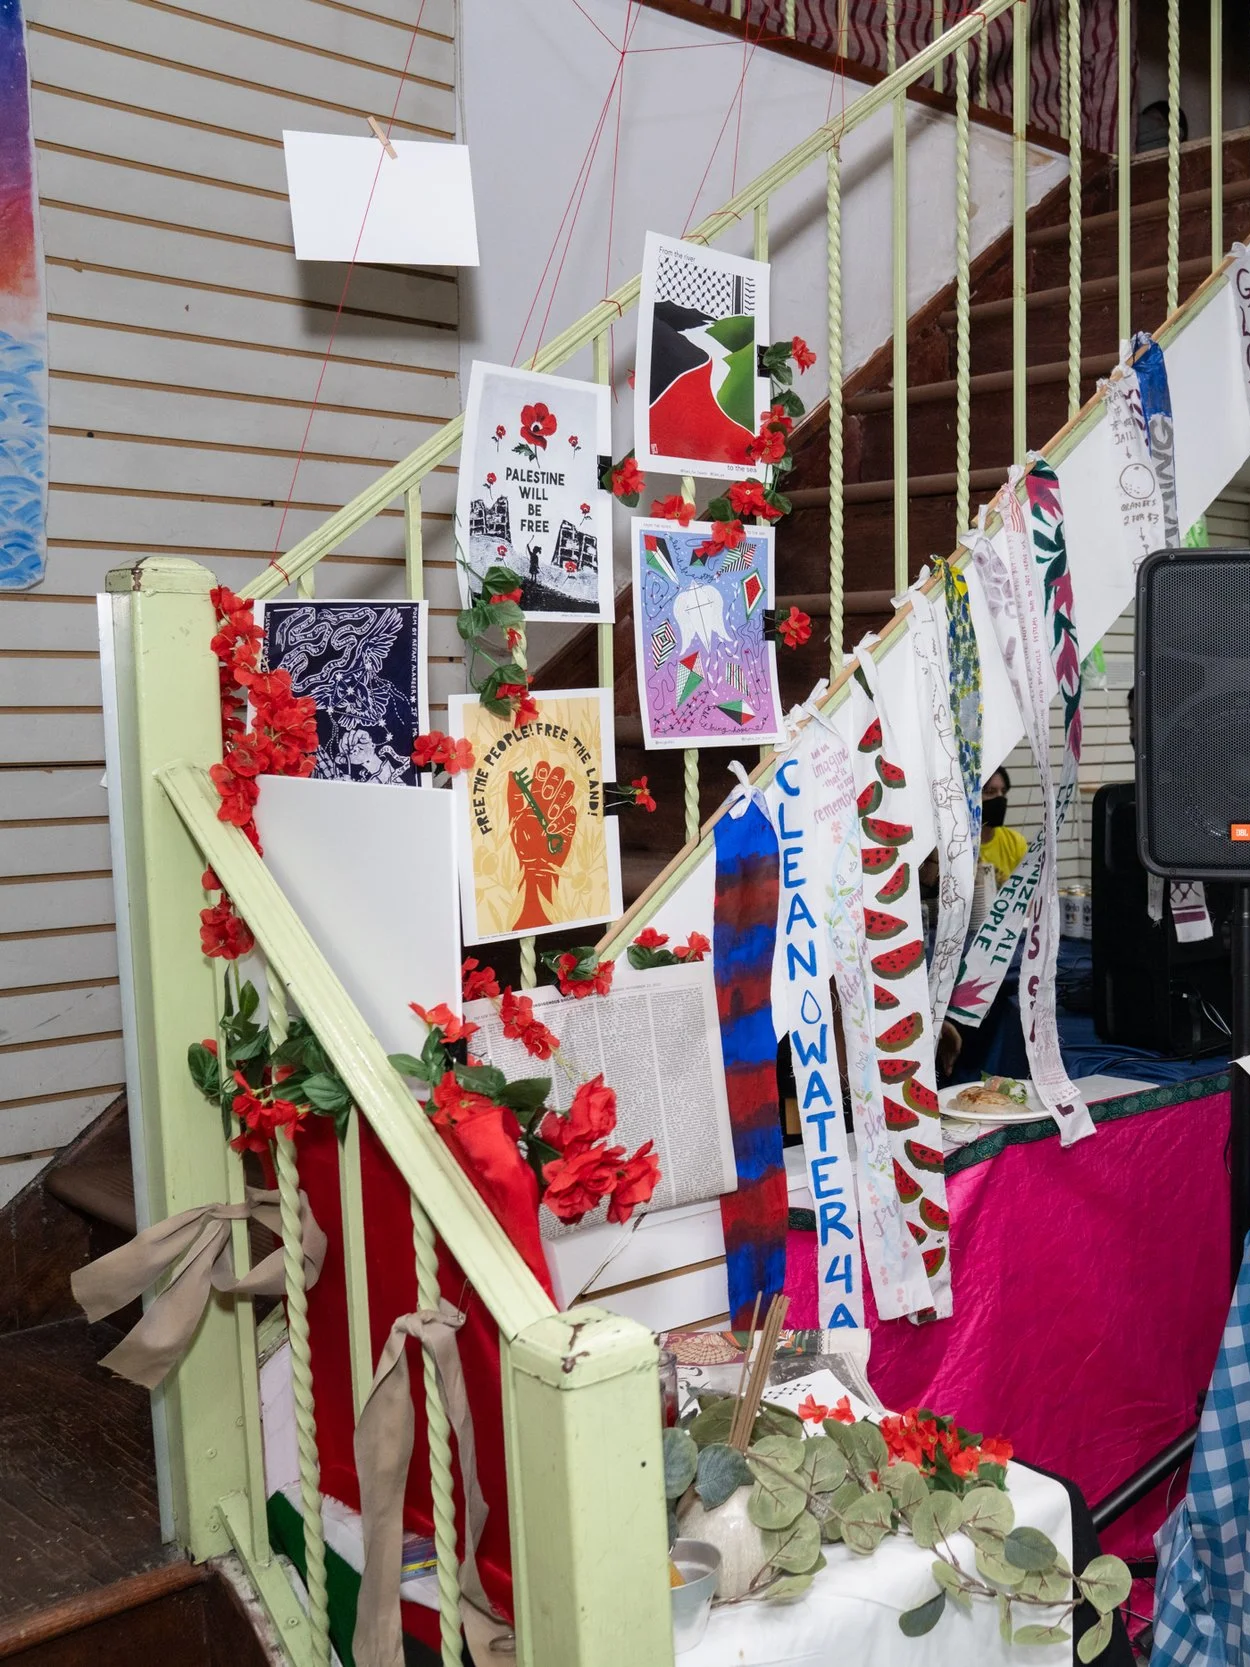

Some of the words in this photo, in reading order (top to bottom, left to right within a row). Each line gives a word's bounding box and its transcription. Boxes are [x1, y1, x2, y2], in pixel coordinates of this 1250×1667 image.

[659, 246, 673, 256] From
[674, 250, 683, 259] the
[685, 253, 696, 262] river
[506, 467, 565, 486] PALESTINE
[735, 465, 745, 473] the
[519, 486, 548, 501] WILL
[528, 504, 542, 516] BE
[1124, 515, 1131, 526] 2
[1132, 514, 1145, 523] FOR
[1147, 513, 1160, 525] $3
[520, 519, 549, 533] FREE
[410, 606, 418, 625] POEM
[410, 627, 418, 636] BY
[409, 638, 418, 662] REFAAT
[409, 664, 418, 696] ALAREER
[484, 723, 534, 767] PEOPLE!
[536, 723, 568, 742] FREE
[573, 736, 592, 765] THE
[812, 747, 849, 778] imagine
[473, 768, 489, 795] THE
[586, 767, 600, 816] LAND!
[473, 796, 492, 835] FREE
[813, 788, 857, 824] remembe
[1235, 828, 1249, 837] JBL
[776, 759, 817, 982] CLEAN
[973, 874, 1025, 953] PEOPLE
[991, 927, 1017, 967] ALL
[791, 1023, 855, 1247] WATER
[825, 1254, 853, 1294] 4
